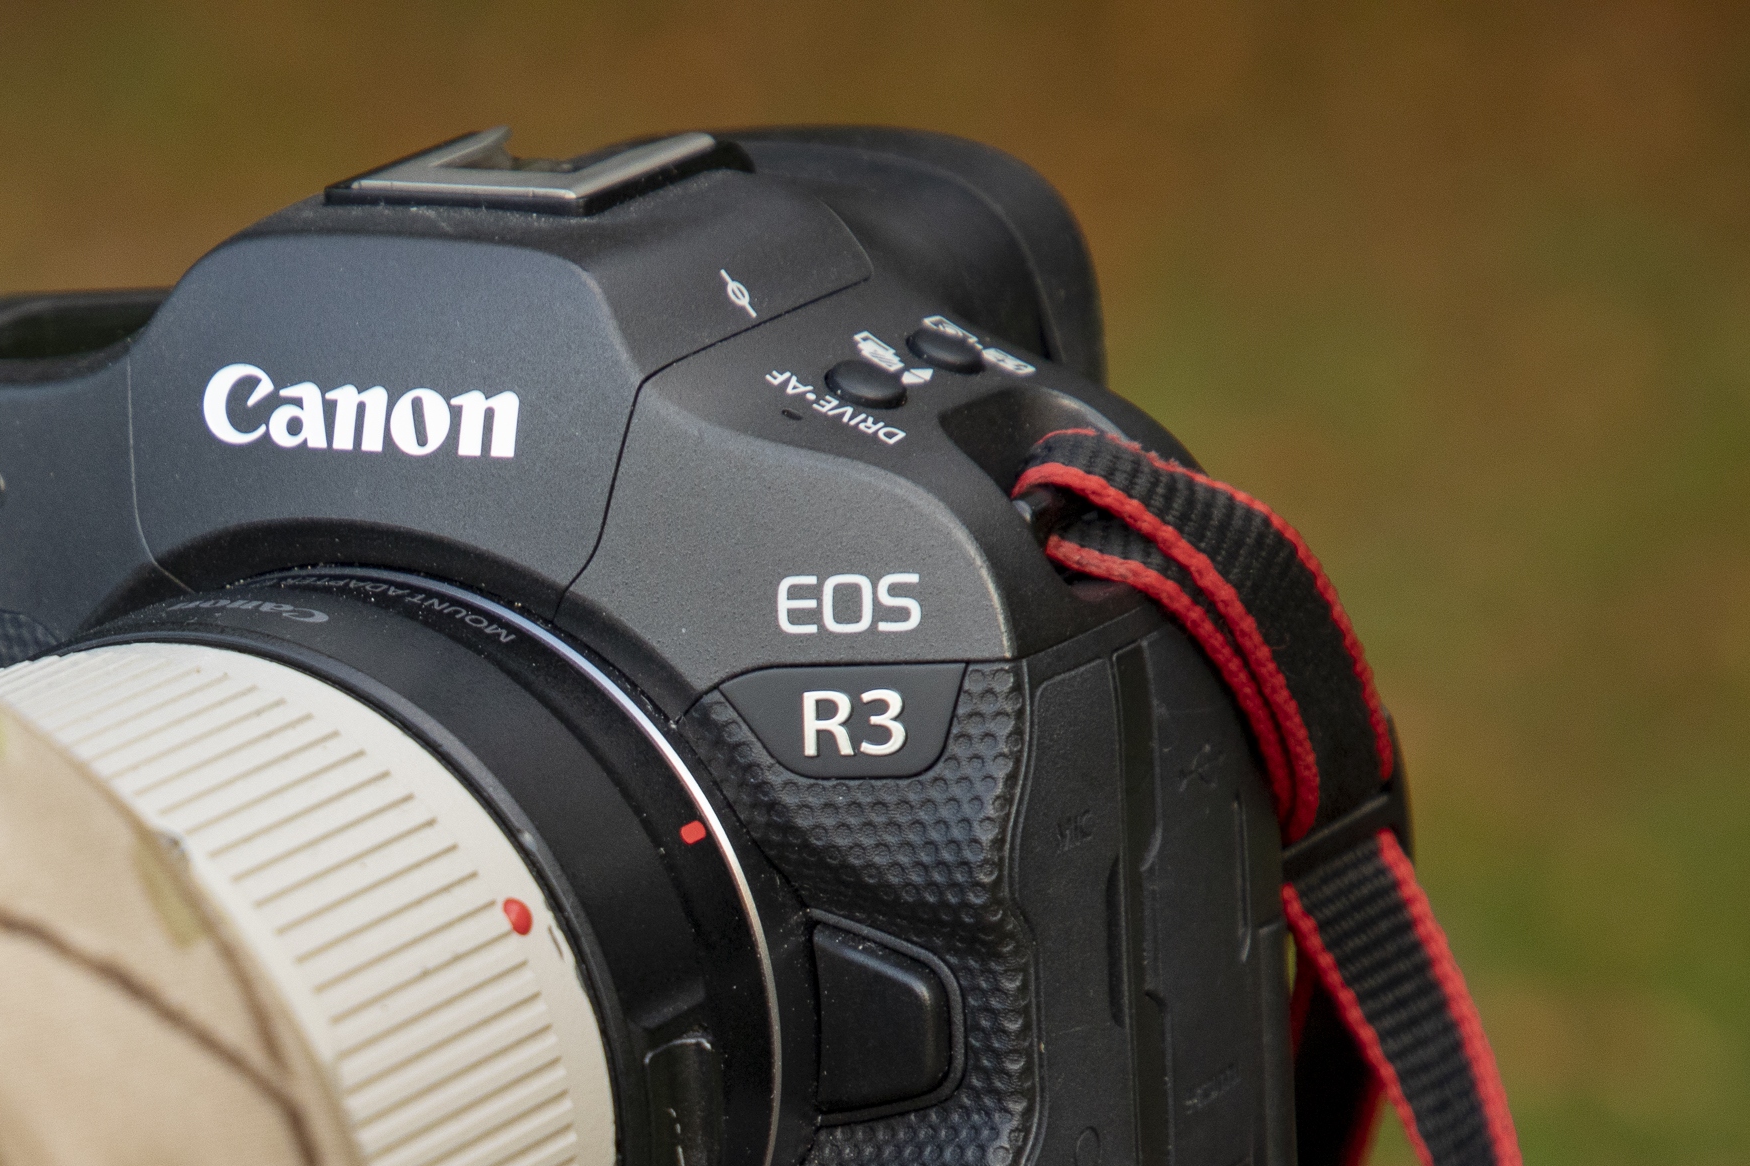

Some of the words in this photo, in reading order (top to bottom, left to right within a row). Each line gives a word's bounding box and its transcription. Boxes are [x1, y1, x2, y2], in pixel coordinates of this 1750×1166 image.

[203, 362, 520, 459] Canon
[166, 599, 329, 623] Canon
[405, 595, 516, 643] MOUNT
[778, 573, 922, 634] EOS
[802, 688, 907, 757] R3
